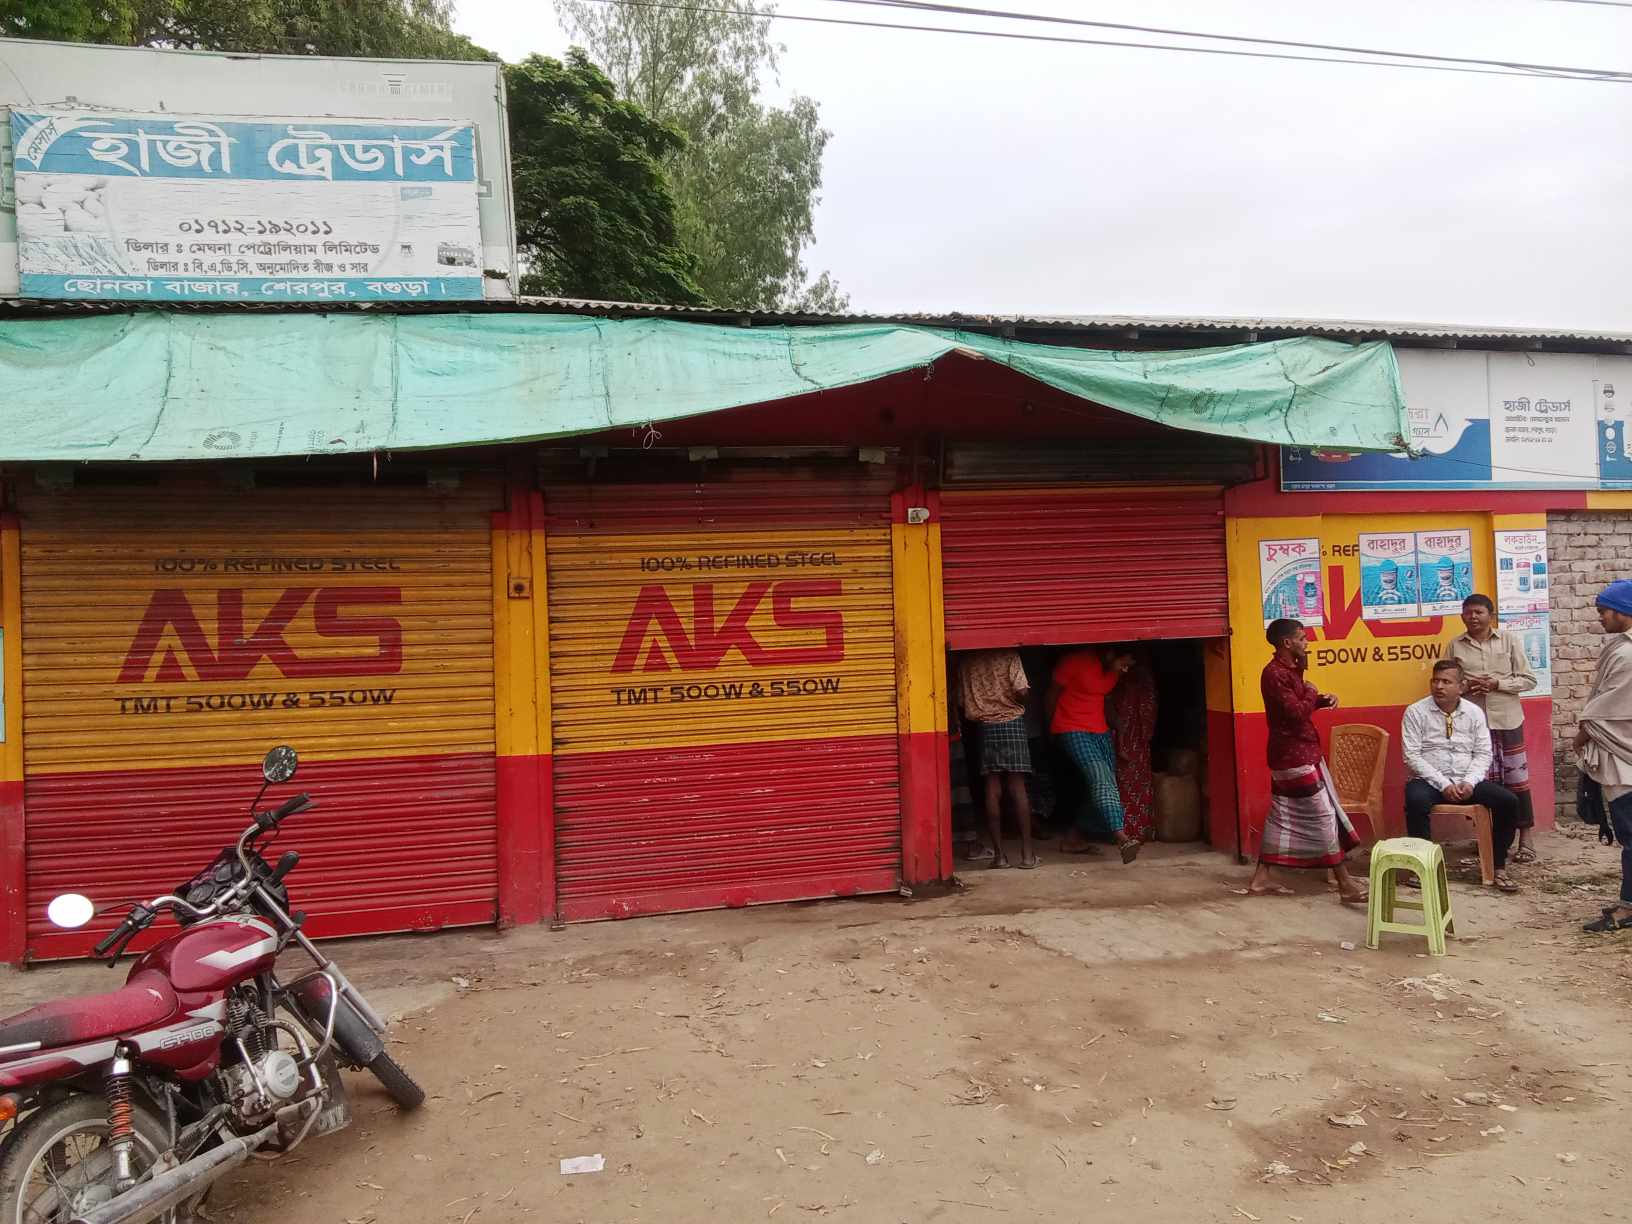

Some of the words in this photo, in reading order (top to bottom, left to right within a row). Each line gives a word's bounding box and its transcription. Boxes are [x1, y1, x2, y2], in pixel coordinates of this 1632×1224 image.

[78, 121, 237, 177] হাজী
[267, 124, 465, 182] ট্রেডার্স
[179, 218, 333, 236] ০১৭১২-১৯২০১১
[124, 238, 169, 256] ডিলার
[189, 242, 231, 254] মেঘনা
[238, 241, 317, 256] পেট্রোলিয়াম
[322, 242, 380, 256] লিমিটেড
[147, 258, 178, 274] ডিলার
[256, 260, 309, 276] অনুমোদিত
[313, 258, 334, 272] বীজ
[338, 262, 346, 272] ও
[351, 262, 368, 273] সার
[63, 277, 151, 296] ছোনকা
[164, 279, 250, 297] বাজার,
[261, 281, 357, 297] শেরপুর,
[366, 279, 430, 297] বগুড়া
[1503, 396, 1530, 411] হাজী
[1534, 399, 1571, 413] ট্রেডার্স
[1367, 538, 1406, 552] বাহাদুর
[1424, 535, 1462, 550] বাহাদুর
[1264, 543, 1307, 562] চুম্বক
[155, 559, 219, 573] 100%
[223, 559, 324, 572] REFINED
[331, 558, 402, 571] STEEL
[641, 556, 692, 573] 100%
[698, 555, 781, 571] REFINED
[784, 552, 842, 568] STEEL
[115, 586, 403, 684] AKS
[610, 580, 845, 674] AKS
[1317, 646, 1369, 667] 500W
[1373, 646, 1385, 662] &
[1388, 642, 1443, 663] 550W
[611, 687, 666, 705] TMT
[670, 682, 744, 702] 500W
[748, 682, 766, 698] &
[770, 677, 841, 696] 550W
[116, 694, 177, 715] TMT
[185, 691, 277, 713] 500W
[282, 693, 301, 709] &
[308, 687, 398, 707] 550W
